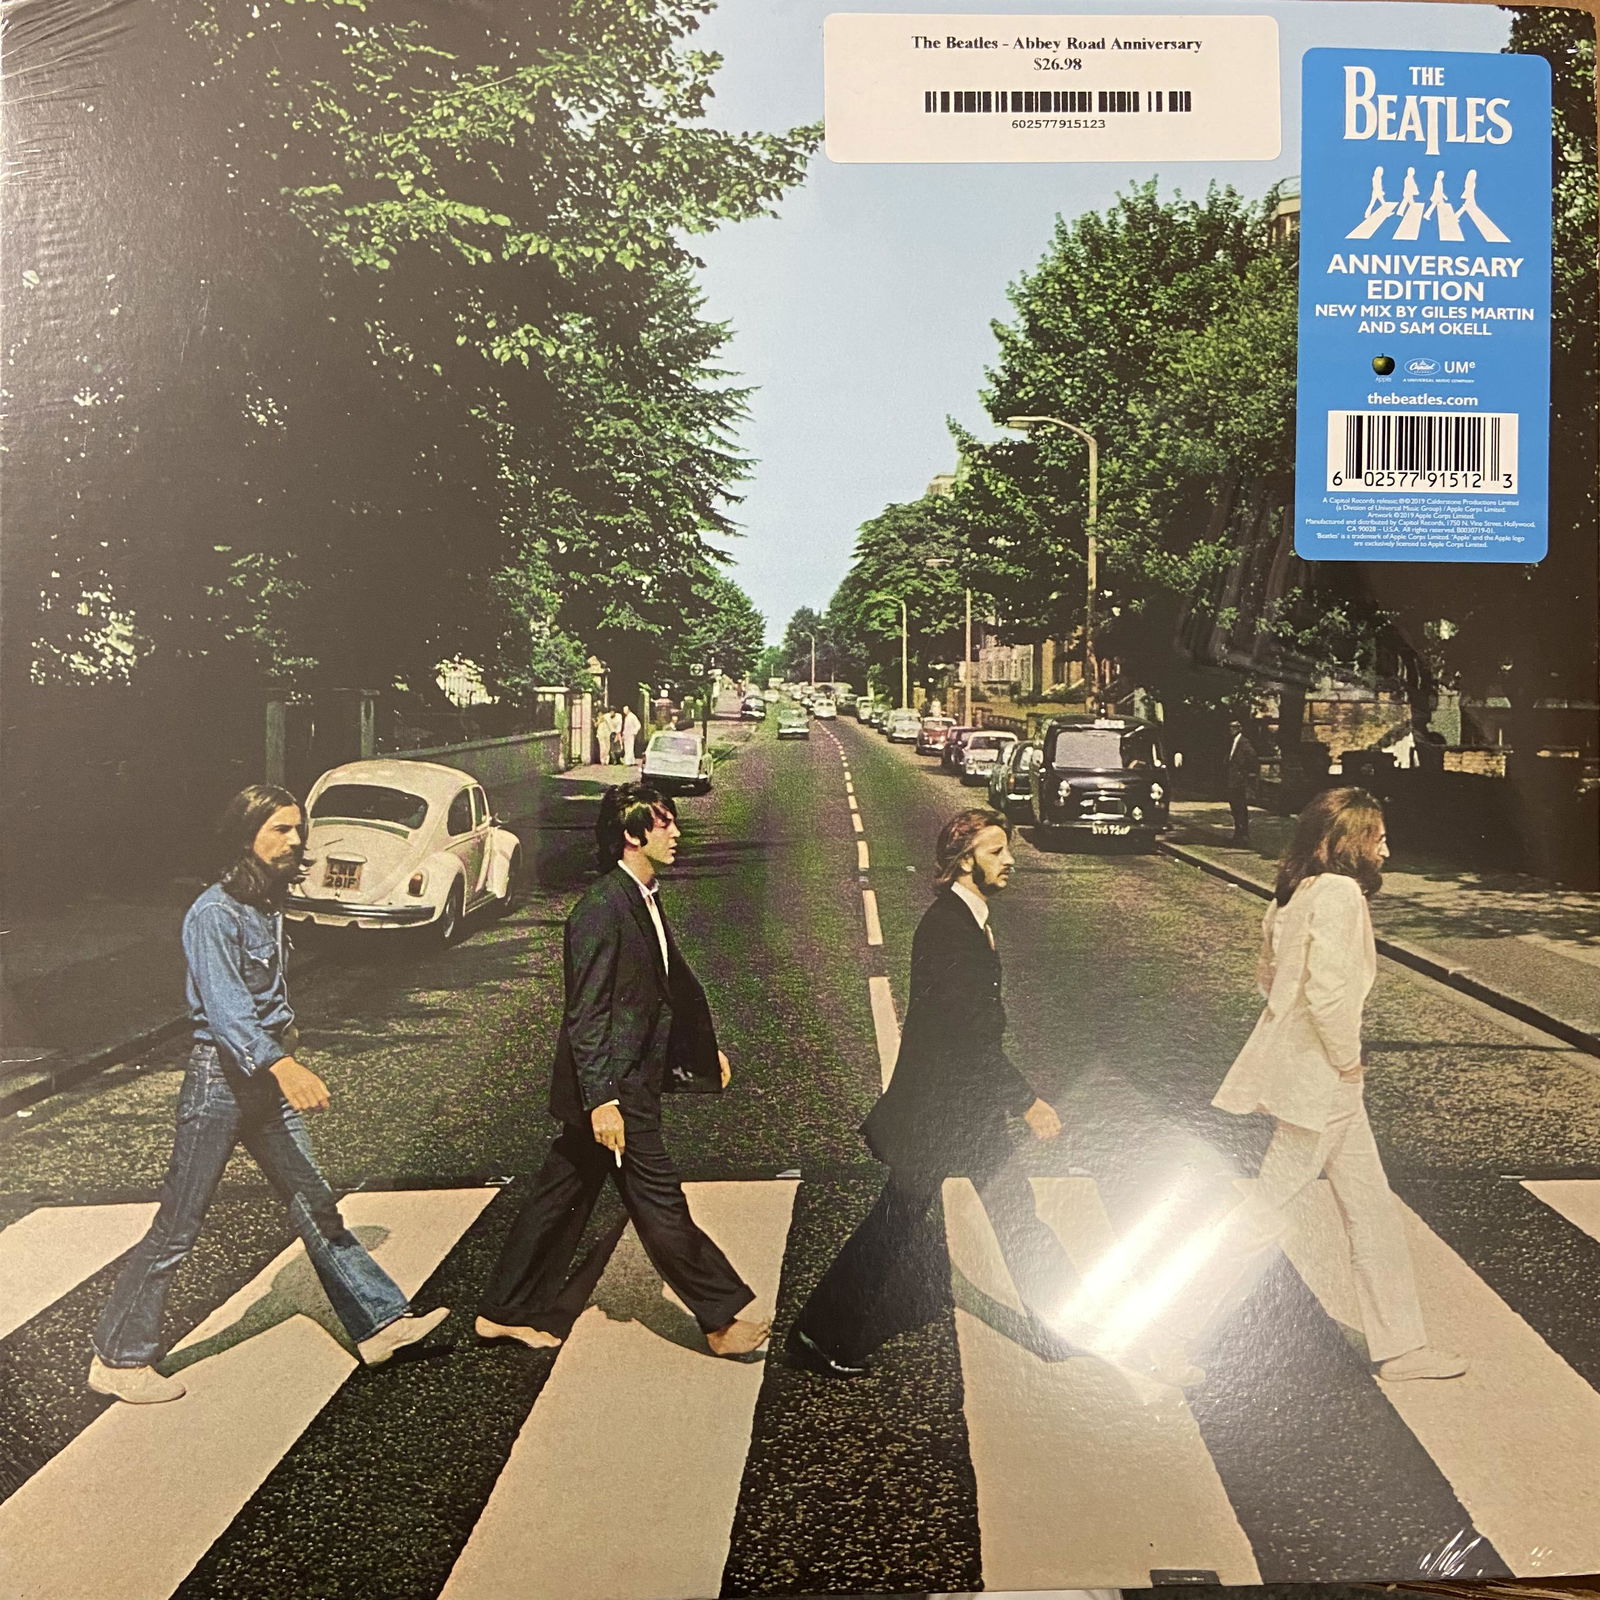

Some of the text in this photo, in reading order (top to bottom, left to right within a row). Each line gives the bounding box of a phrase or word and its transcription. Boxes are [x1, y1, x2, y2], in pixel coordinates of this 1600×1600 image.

[912, 36, 940, 49] The
[946, 36, 998, 49] Beatles
[1013, 37, 1060, 52] Abbey
[1067, 37, 1106, 50] Road
[1111, 38, 1202, 53] Anniversary
[1034, 58, 1082, 71] $26.98
[1409, 67, 1444, 86] THE
[1343, 66, 1512, 155] BEATLES
[1012, 119, 1106, 129] 602577915123
[1327, 254, 1524, 278] ANNIVERSARY
[1367, 279, 1484, 301] EDITION
[1315, 304, 1534, 321] NEW MIX BY GILES MARTIN
[1358, 321, 1492, 336] AND SAM OKELL
[1368, 392, 1478, 405] thebeatles.com
[1333, 472, 1512, 488] 6 02577 91512 3
